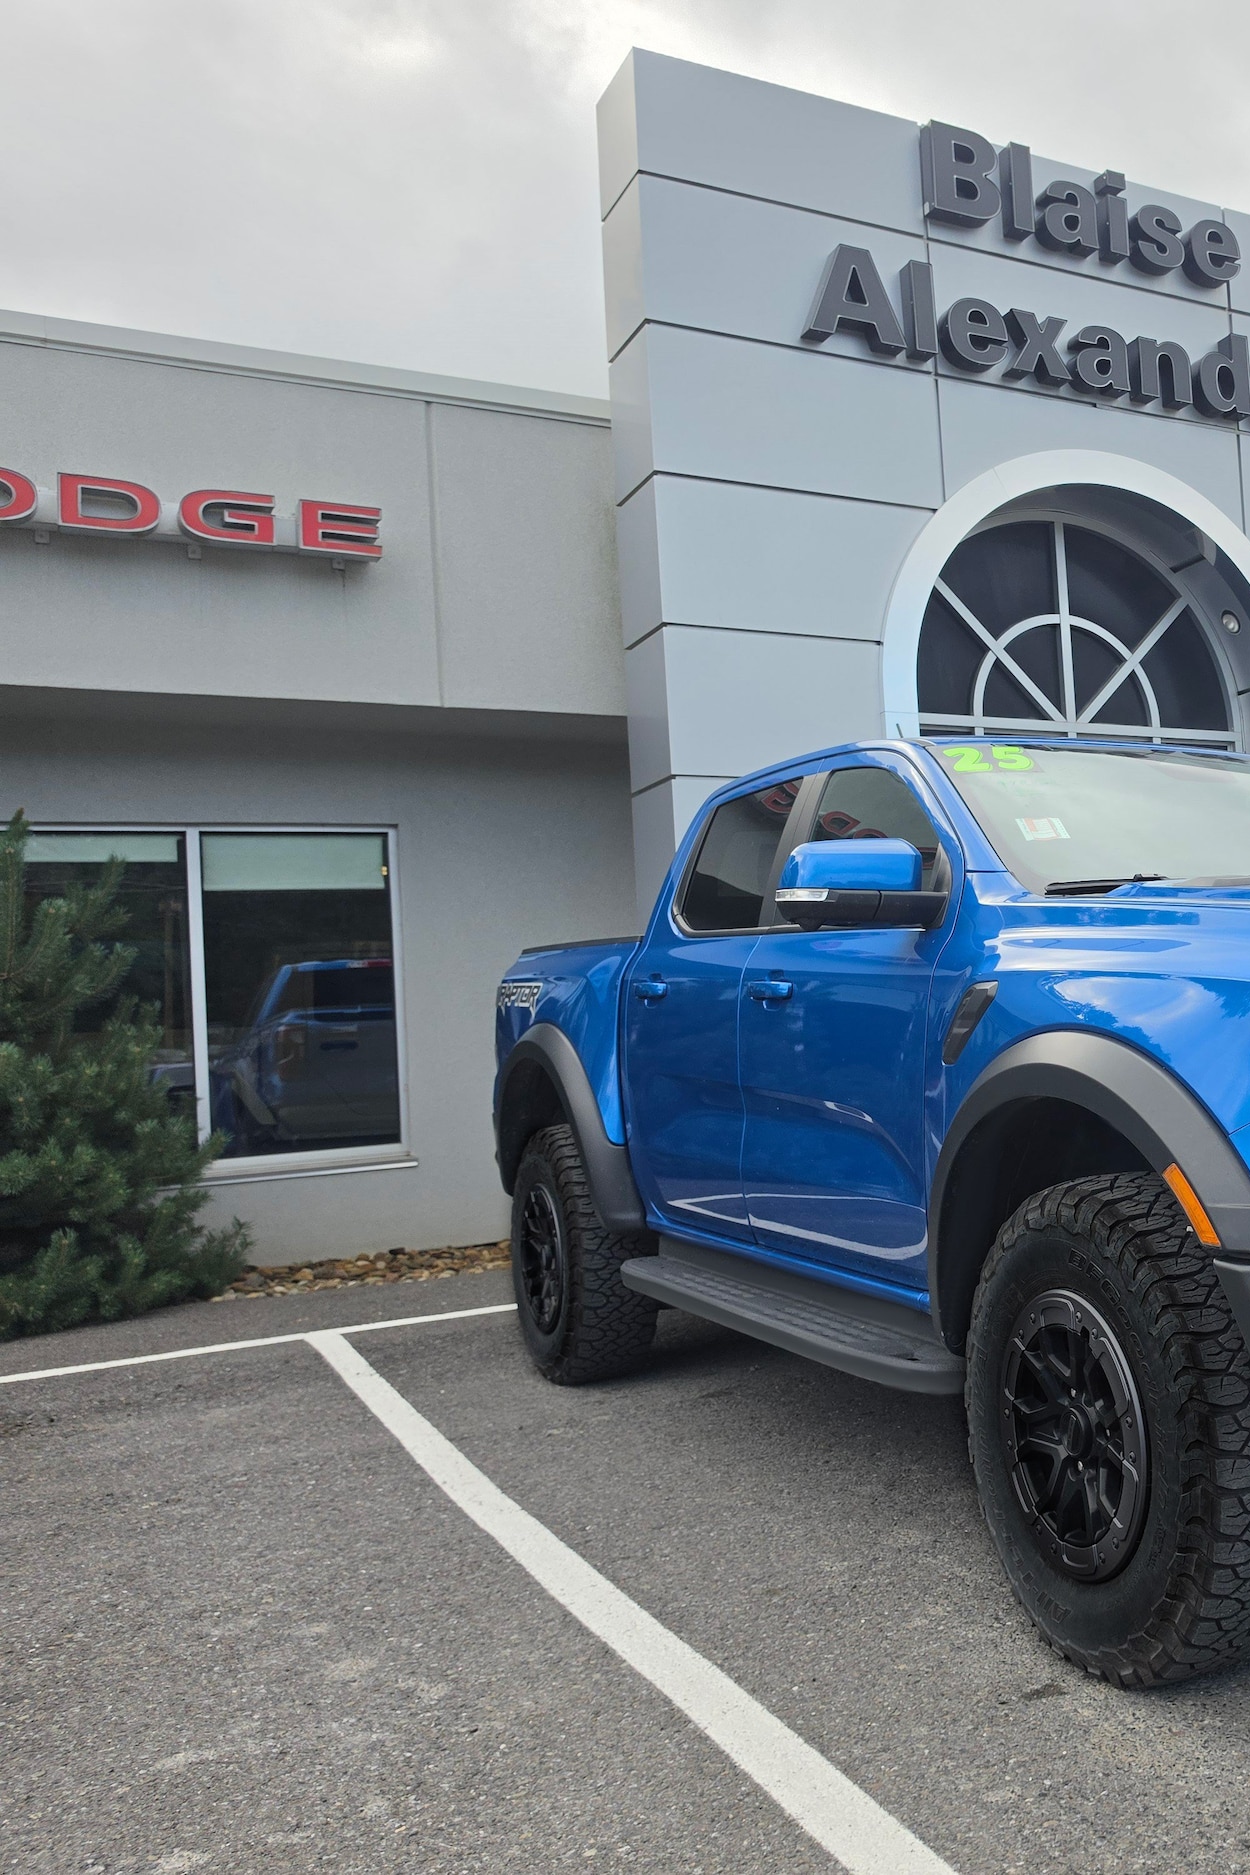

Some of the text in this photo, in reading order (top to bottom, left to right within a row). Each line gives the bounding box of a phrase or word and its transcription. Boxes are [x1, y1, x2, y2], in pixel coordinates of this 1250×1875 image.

[920, 119, 1242, 288] Blaise
[943, 746, 1034, 772] 25
[497, 982, 543, 1020] RAPTOR
